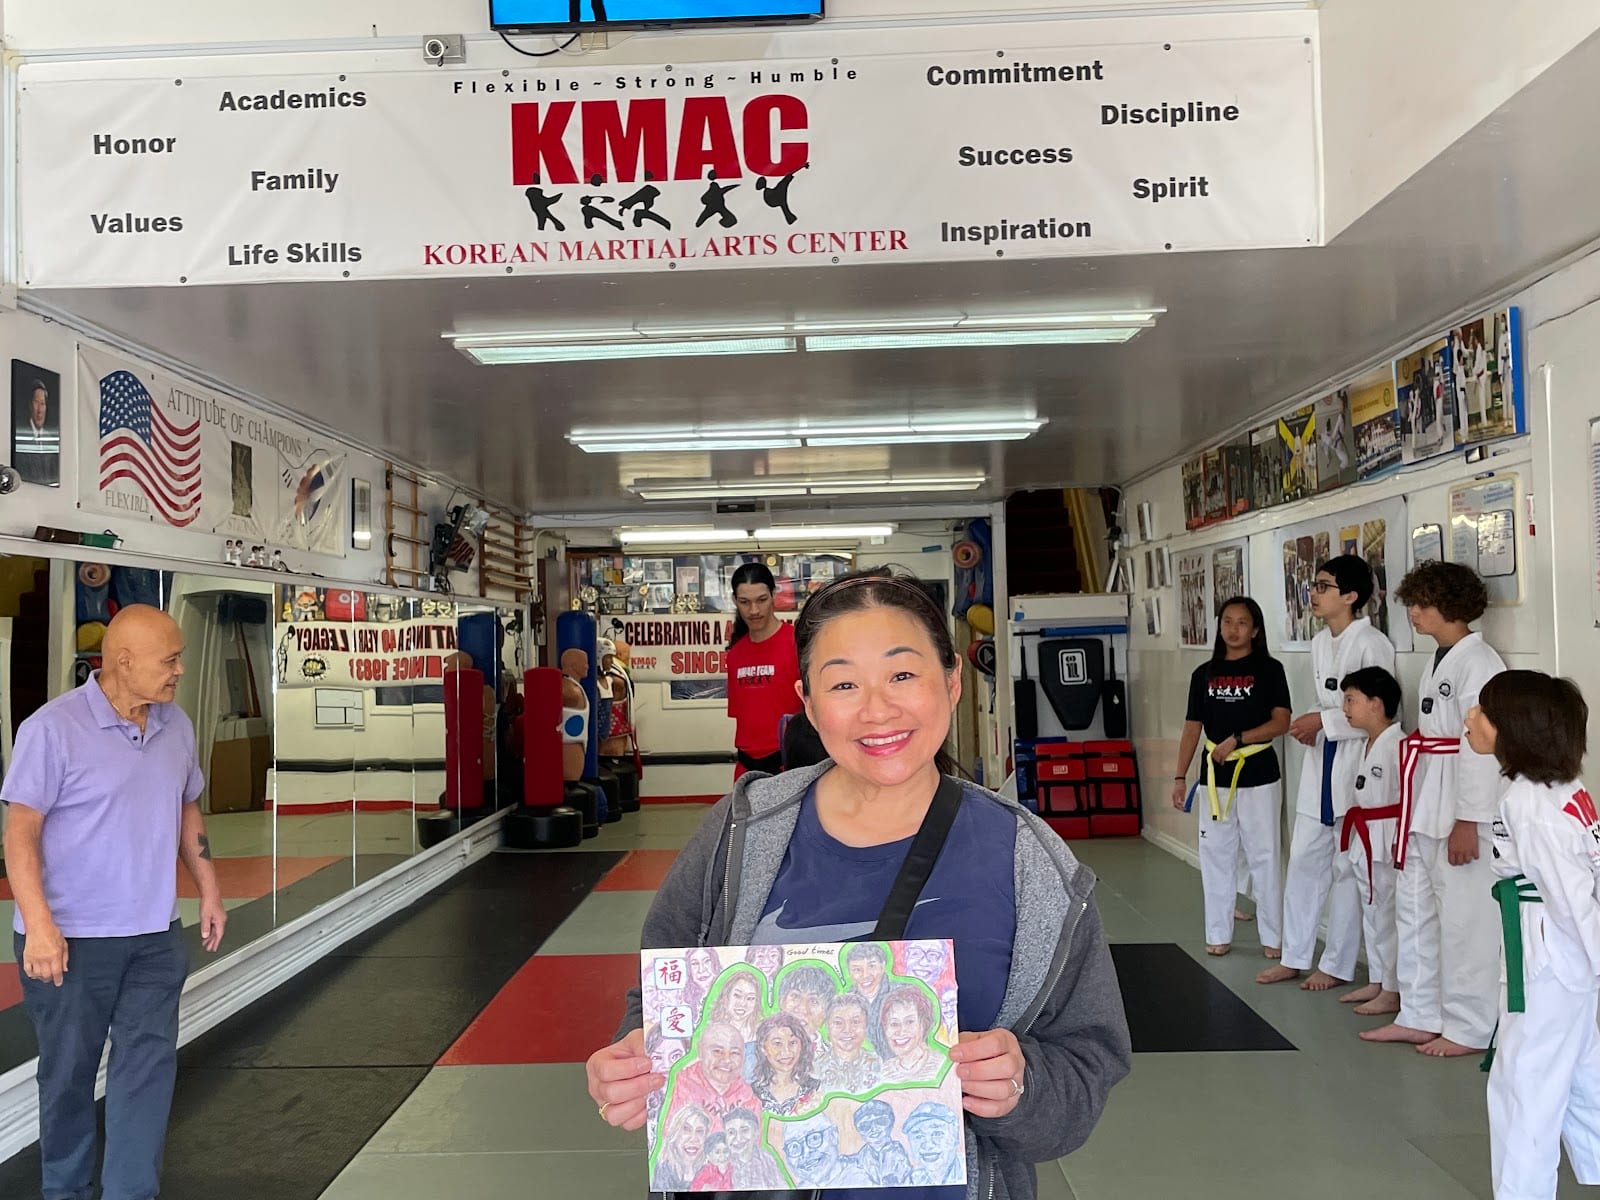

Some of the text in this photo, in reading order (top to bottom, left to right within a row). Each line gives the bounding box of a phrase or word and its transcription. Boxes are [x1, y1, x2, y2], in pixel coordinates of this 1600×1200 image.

[453, 67, 858, 94] Flexible Strong Humble
[926, 60, 1104, 86] Commitment
[218, 86, 367, 112] Academics
[1101, 101, 1239, 127] Discipline
[93, 134, 177, 155] Honor
[511, 94, 809, 185] KMAC
[958, 146, 1073, 166] Success
[251, 168, 339, 193] Family
[1132, 176, 1209, 202] Spirit
[90, 212, 183, 234] Values
[941, 217, 1092, 243] Inspiration
[228, 241, 362, 266] Life Skills
[424, 228, 909, 266] KOREAN MARTIAL ARTS CENTER
[167, 387, 303, 458] ATTITUDE OF CHAMPIONS
[625, 620, 711, 647] CELEBRATING
[713, 620, 723, 646] A
[631, 656, 657, 667] KMAC
[671, 651, 729, 675] SINCE
[659, 961, 682, 984] 福
[666, 1007, 687, 1034] 愛
